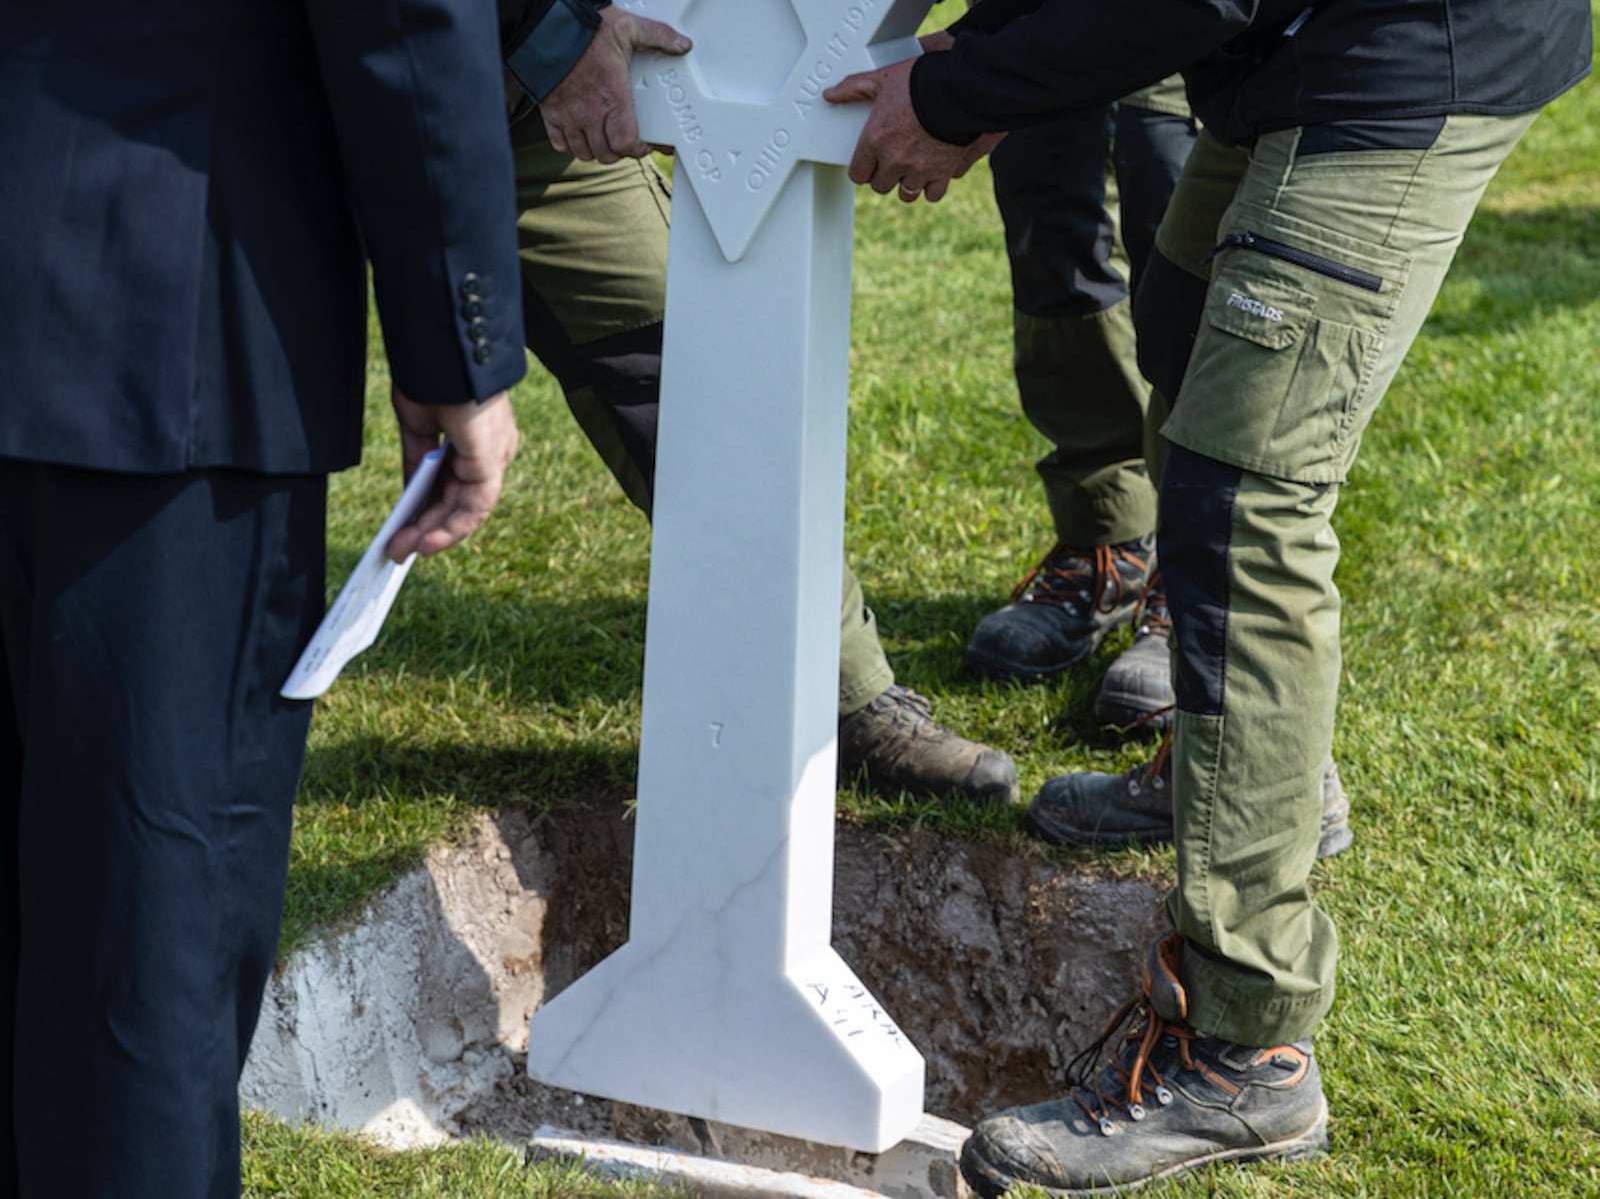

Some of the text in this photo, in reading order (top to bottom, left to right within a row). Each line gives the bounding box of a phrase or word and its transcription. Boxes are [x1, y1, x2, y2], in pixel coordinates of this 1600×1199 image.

[656, 68, 703, 144] BOMB
[695, 149, 723, 183] GP
[745, 128, 790, 193] OHIO
[793, 60, 833, 121] AUG
[825, 32, 850, 60] 17
[708, 721, 725, 748] 7
